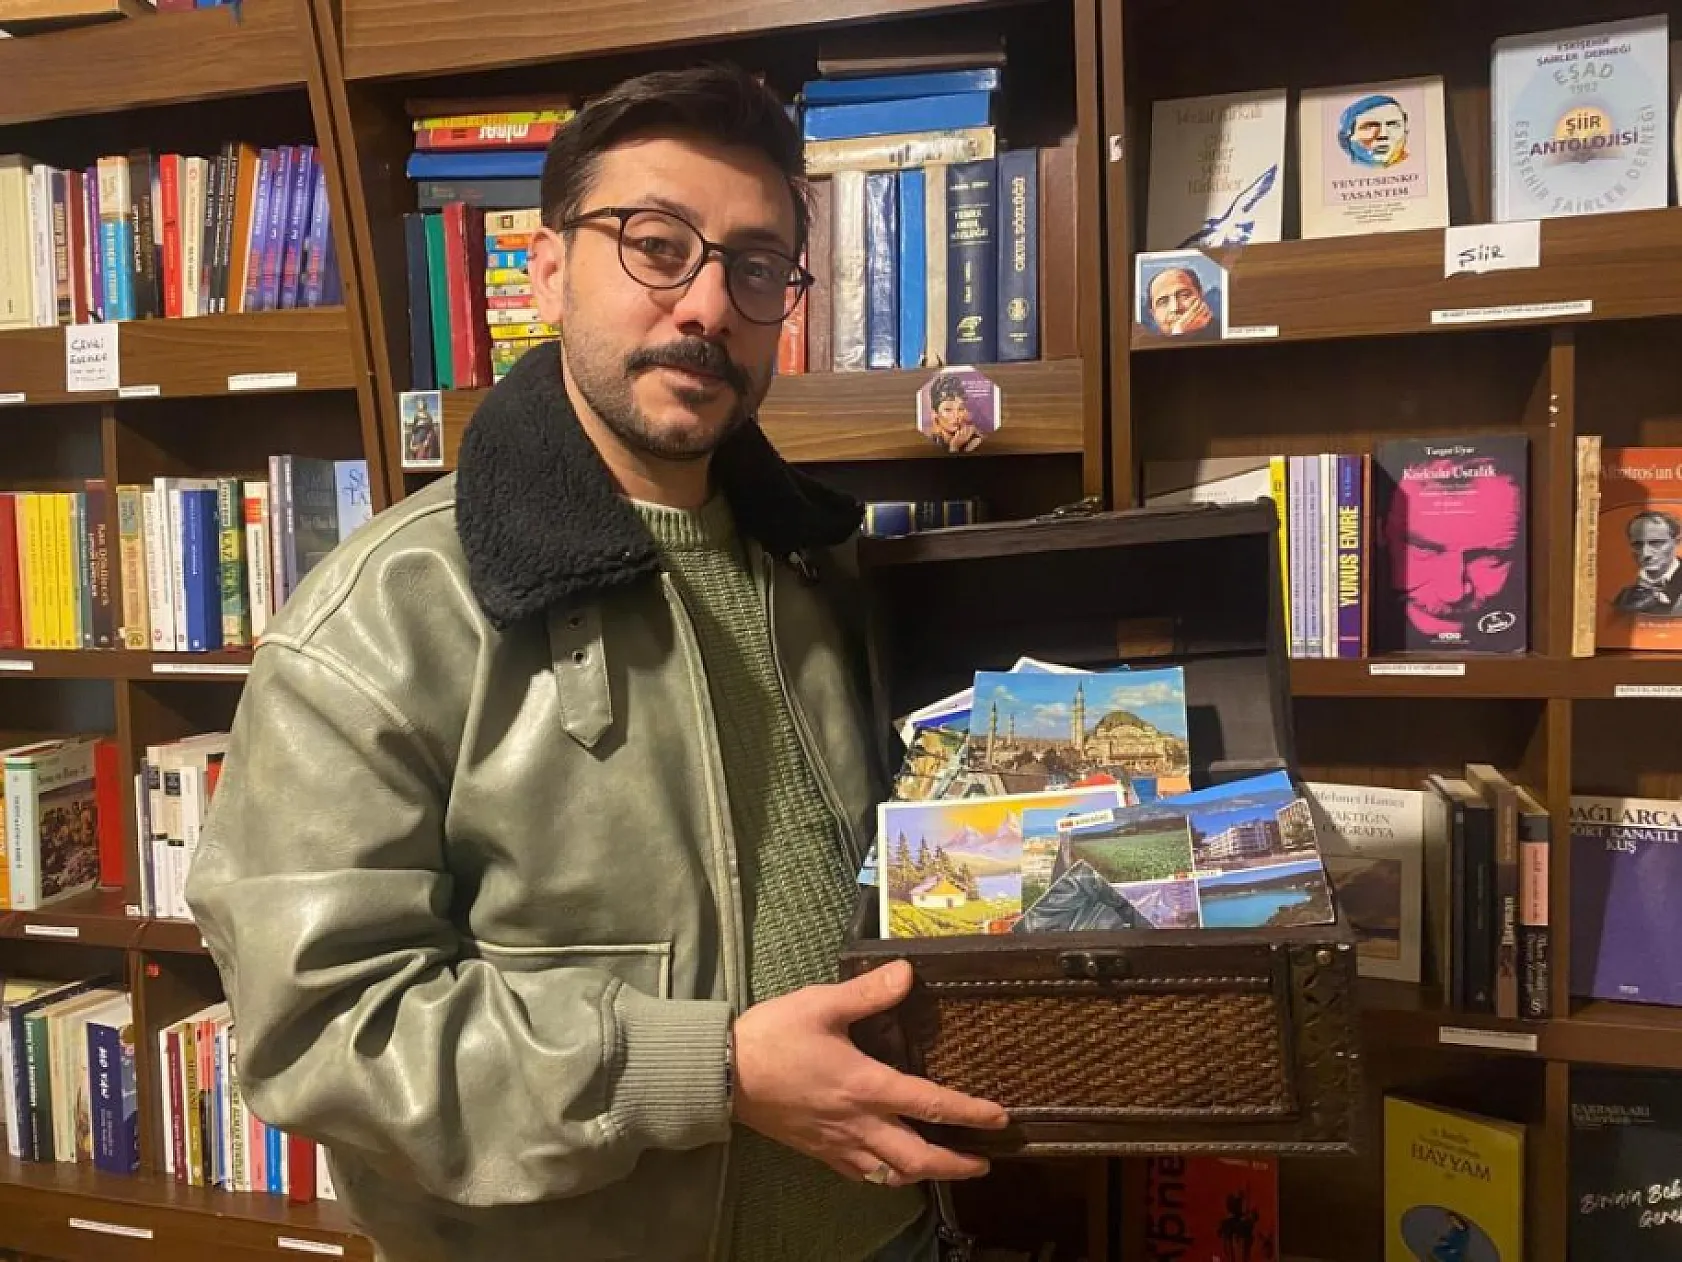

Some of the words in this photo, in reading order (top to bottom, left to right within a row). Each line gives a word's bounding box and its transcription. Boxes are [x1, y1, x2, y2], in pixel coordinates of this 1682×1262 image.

[1530, 127, 1640, 157] ANTOLOJİSİ
[1338, 505, 1360, 552] EMRE
[1338, 554, 1360, 607] YUNUS
[1570, 804, 1681, 827] AĞLARCA
[1410, 1142, 1493, 1183] HAYYAM
